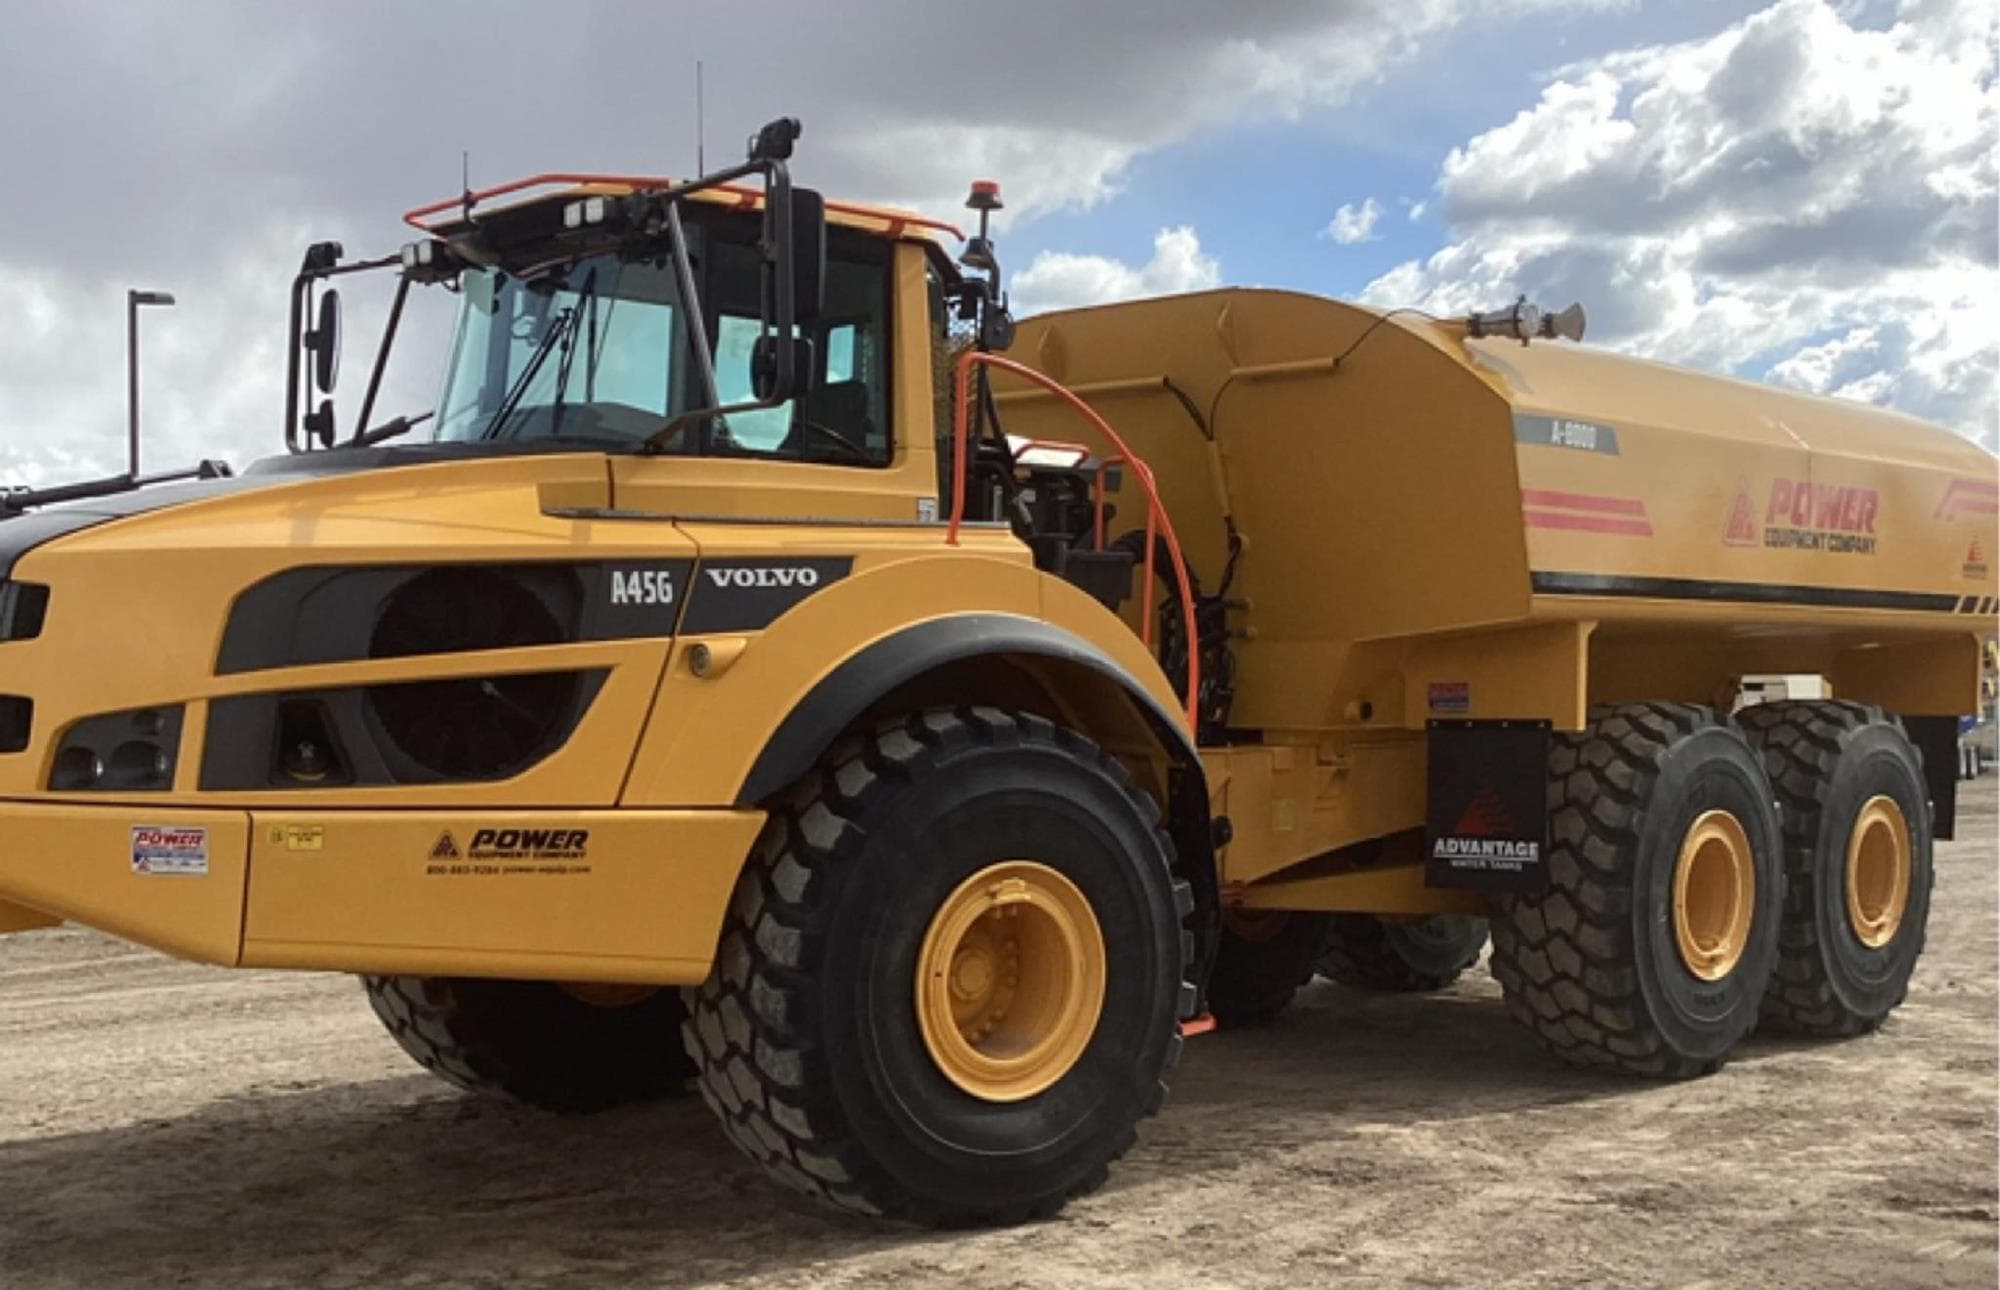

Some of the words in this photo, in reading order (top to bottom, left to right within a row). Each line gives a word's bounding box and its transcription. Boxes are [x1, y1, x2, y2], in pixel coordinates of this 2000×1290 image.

[1765, 477, 1879, 533] POWER
[1764, 527, 1826, 550] EQUIPMENT
[1828, 532, 1876, 555] COMPANY
[611, 570, 673, 604] A45G
[705, 567, 818, 587] VOLVO
[135, 831, 204, 846] POWER
[469, 829, 589, 849] POWER
[1433, 837, 1539, 857] ADVANTAGE
[468, 850, 530, 858] EQUIPMENT
[533, 850, 587, 858] COMPANY
